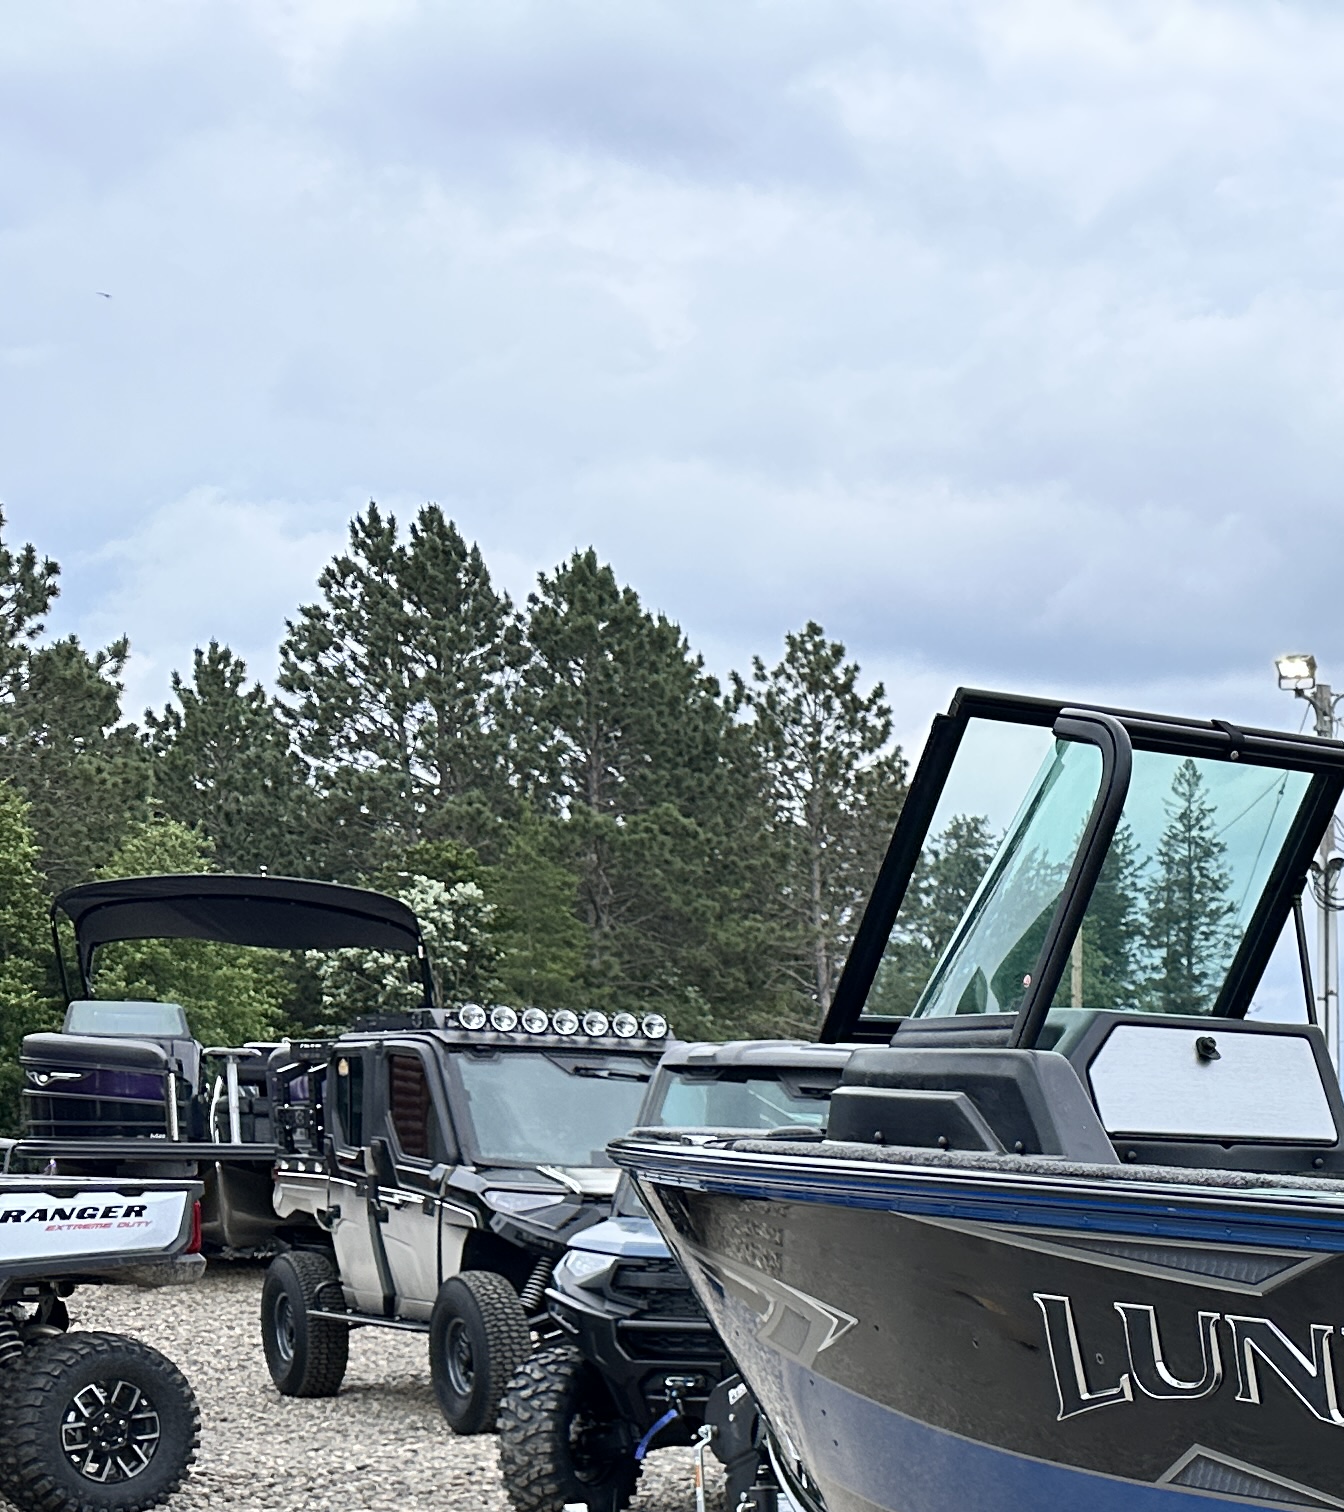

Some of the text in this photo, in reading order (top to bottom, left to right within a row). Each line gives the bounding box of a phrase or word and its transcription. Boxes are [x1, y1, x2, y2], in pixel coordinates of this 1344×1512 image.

[0, 1204, 148, 1224] RANGER
[44, 1220, 153, 1232] EXTREME DUTY
